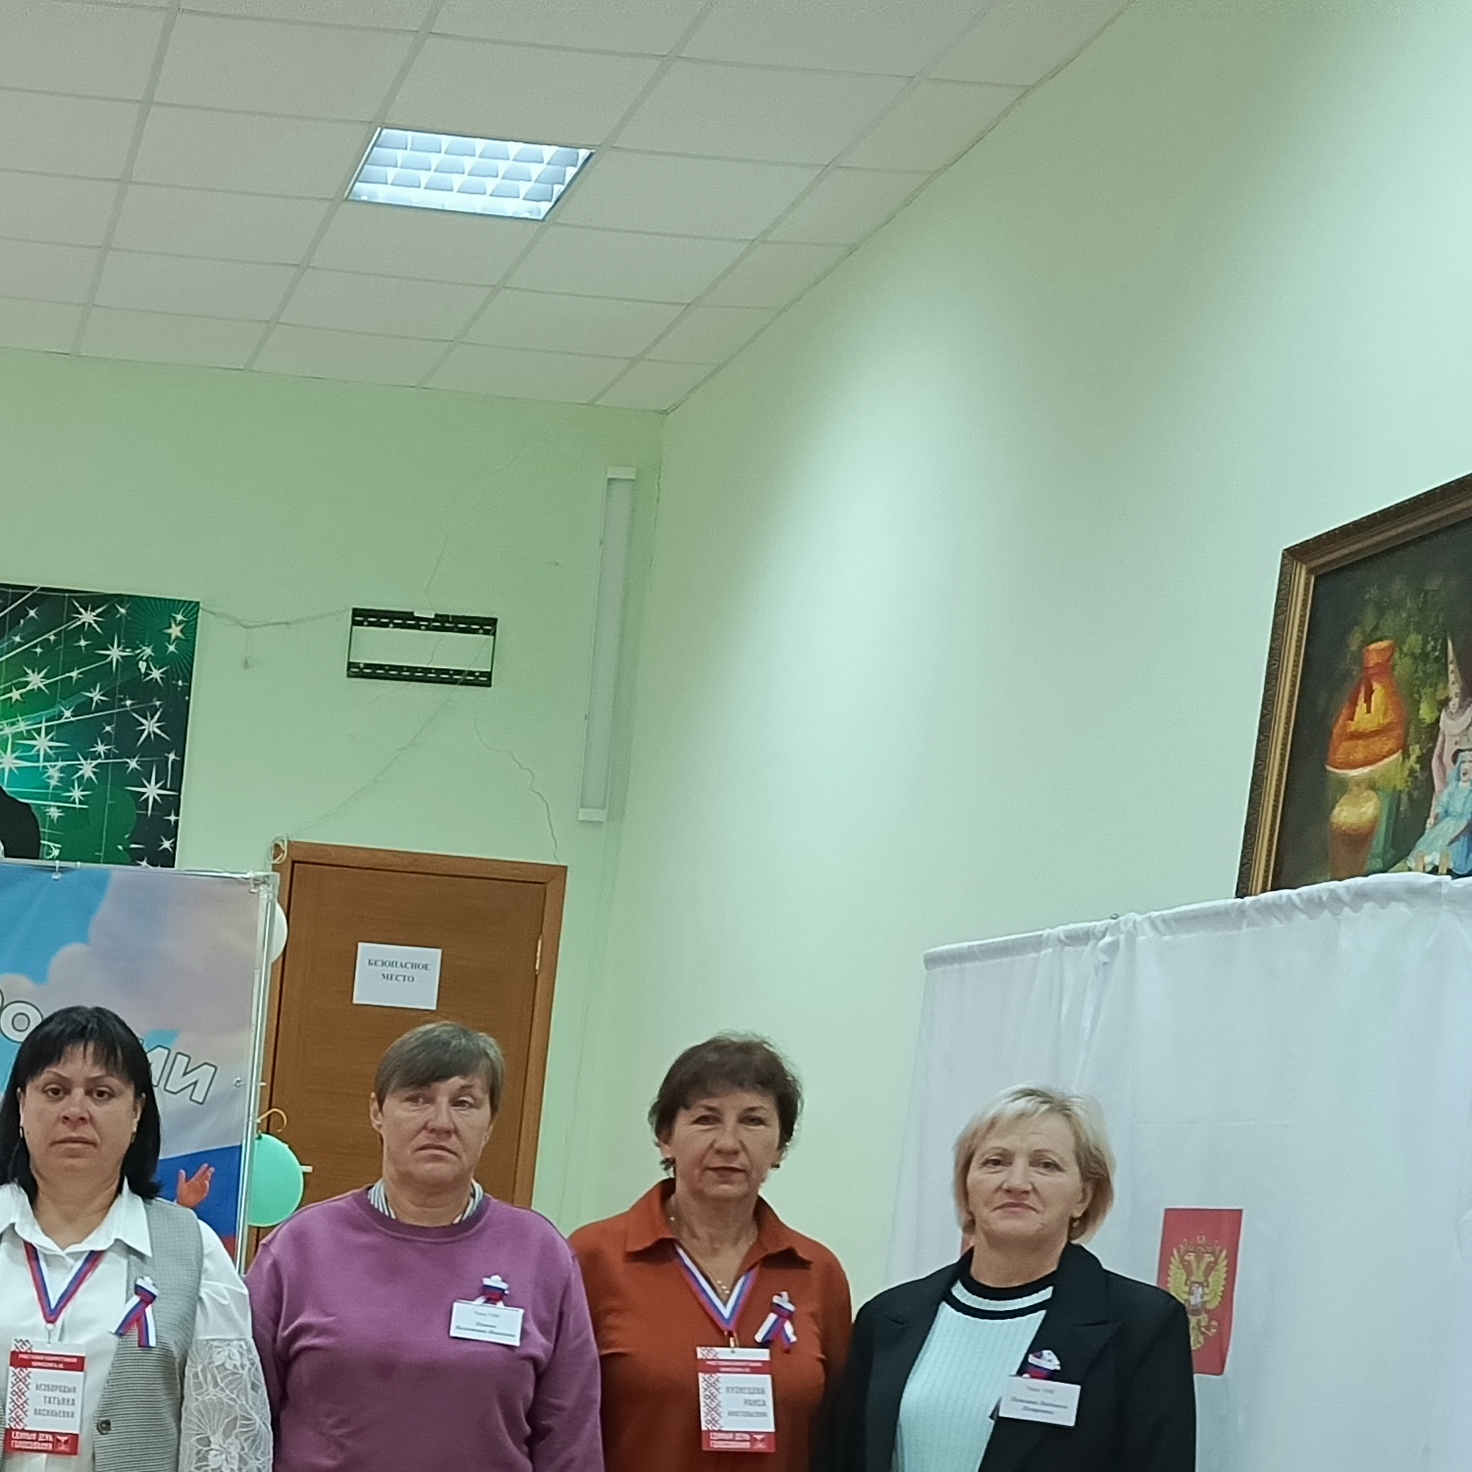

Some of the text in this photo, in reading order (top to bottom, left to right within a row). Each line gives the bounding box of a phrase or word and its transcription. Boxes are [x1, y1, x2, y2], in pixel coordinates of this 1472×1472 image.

[367, 958, 431, 971] БЕЗОПАСНОЕ
[381, 972, 415, 983] МЕСТО
[43, 1395, 76, 1406] ТАТЬЯНА
[33, 1408, 75, 1418] ВАСИЛЬЕВНА
